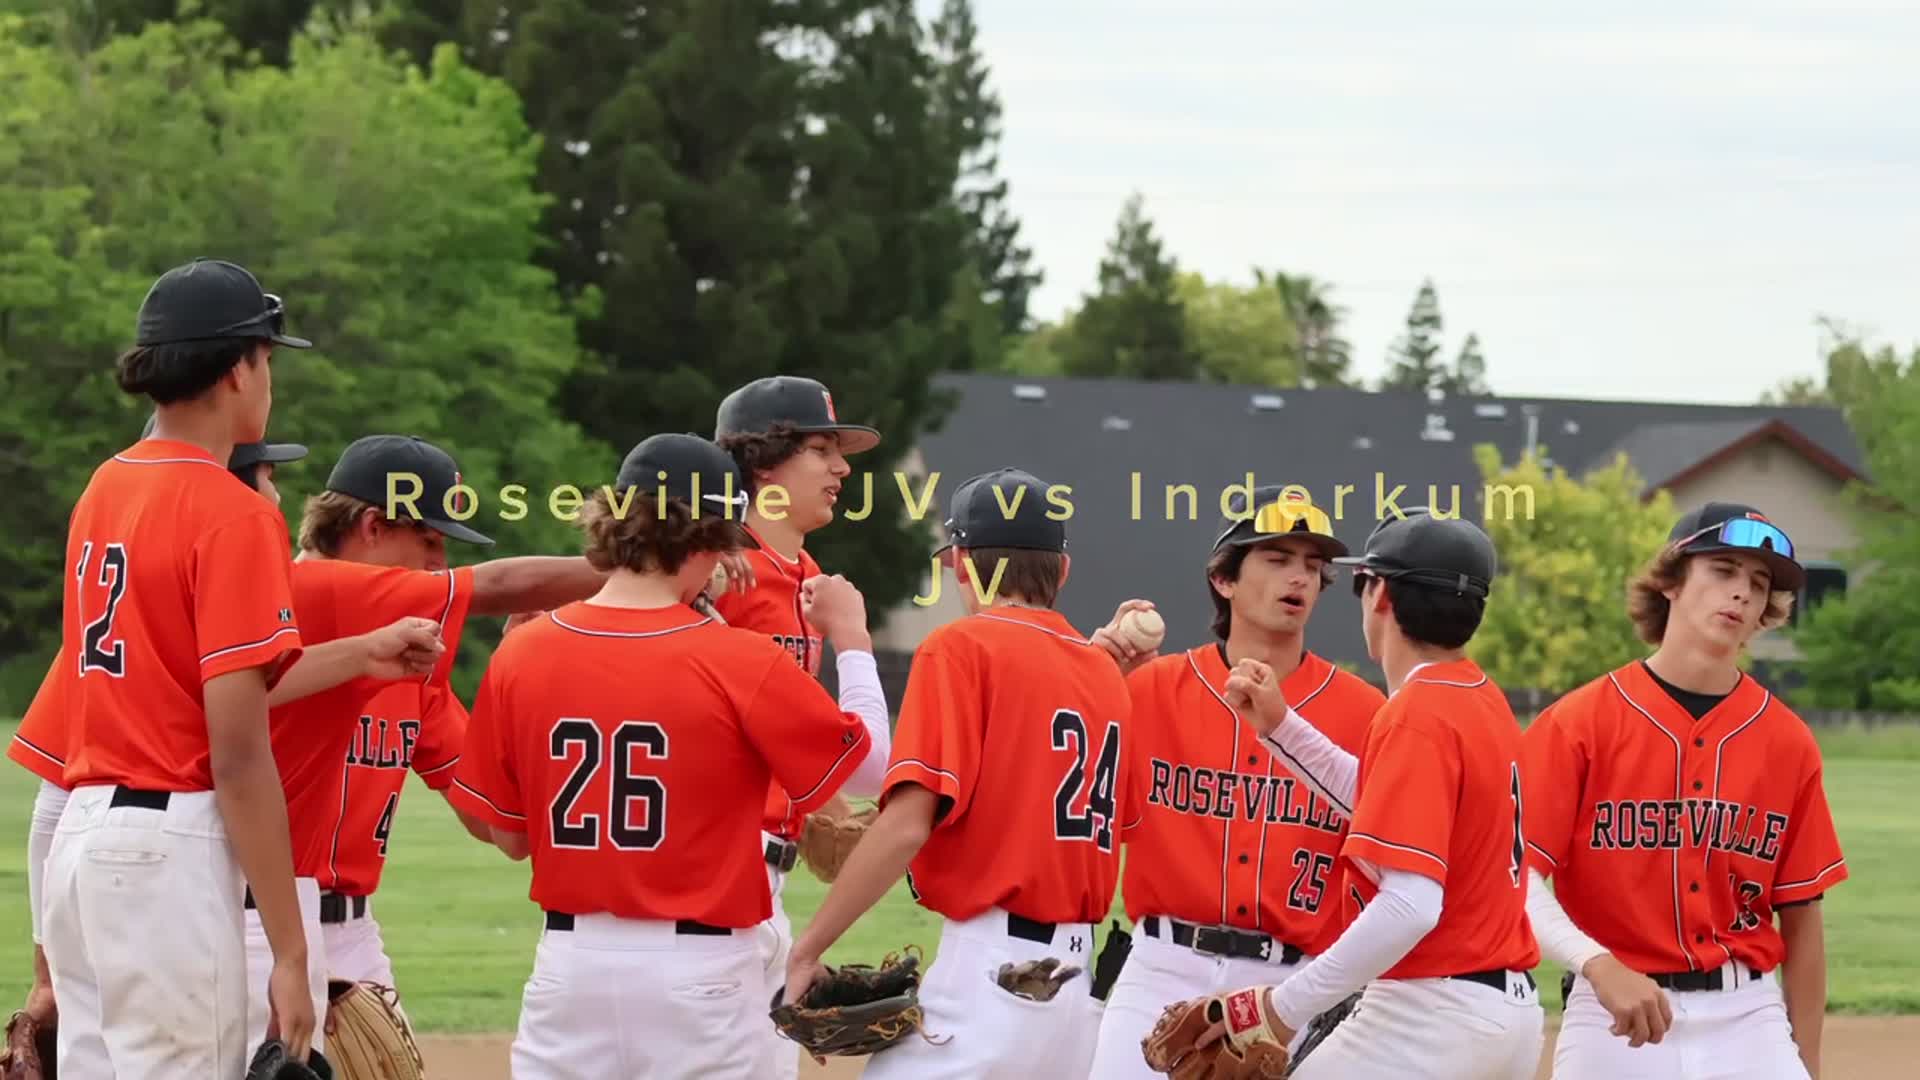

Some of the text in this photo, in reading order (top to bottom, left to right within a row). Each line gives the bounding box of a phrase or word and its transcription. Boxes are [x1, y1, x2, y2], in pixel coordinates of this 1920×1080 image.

[549, 717, 669, 851] 26
[1051, 708, 1120, 854] 24
[373, 791, 398, 857] 4
[1590, 797, 1789, 863] ROSEVILLE
[1286, 847, 1334, 915] 25
